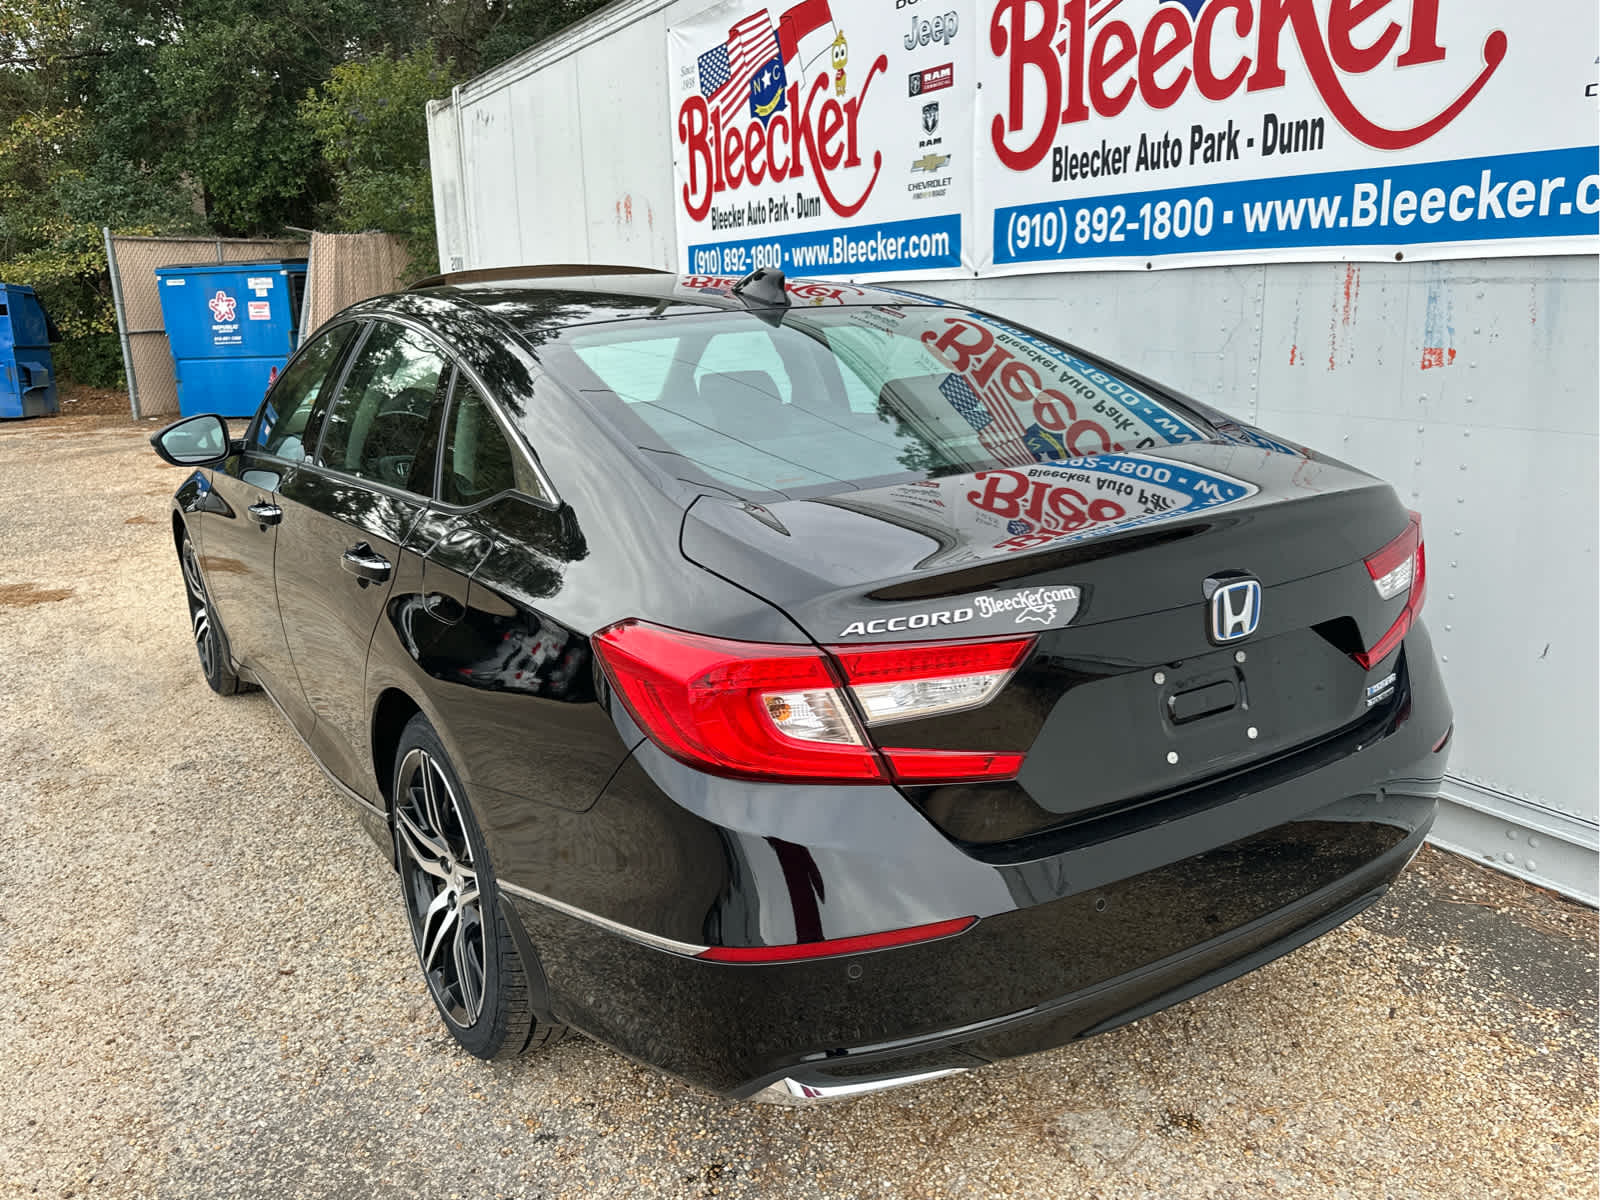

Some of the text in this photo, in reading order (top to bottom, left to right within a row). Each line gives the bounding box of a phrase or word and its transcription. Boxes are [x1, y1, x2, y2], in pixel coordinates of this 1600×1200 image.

[904, 11, 959, 51] Jeep
[923, 67, 951, 82] RAM
[919, 137, 942, 148] RAM
[1051, 113, 1325, 183] Bleecker Auto Park Dunn
[907, 177, 952, 192] CHEVROLET
[711, 192, 821, 231] Bleecker Auto Park Dunn
[1007, 206, 1068, 257] (910)
[1074, 196, 1214, 245] 892-1800
[694, 231, 950, 275] (910) 892-1800 www.Bleecker.com
[840, 607, 974, 637] ACCORD
